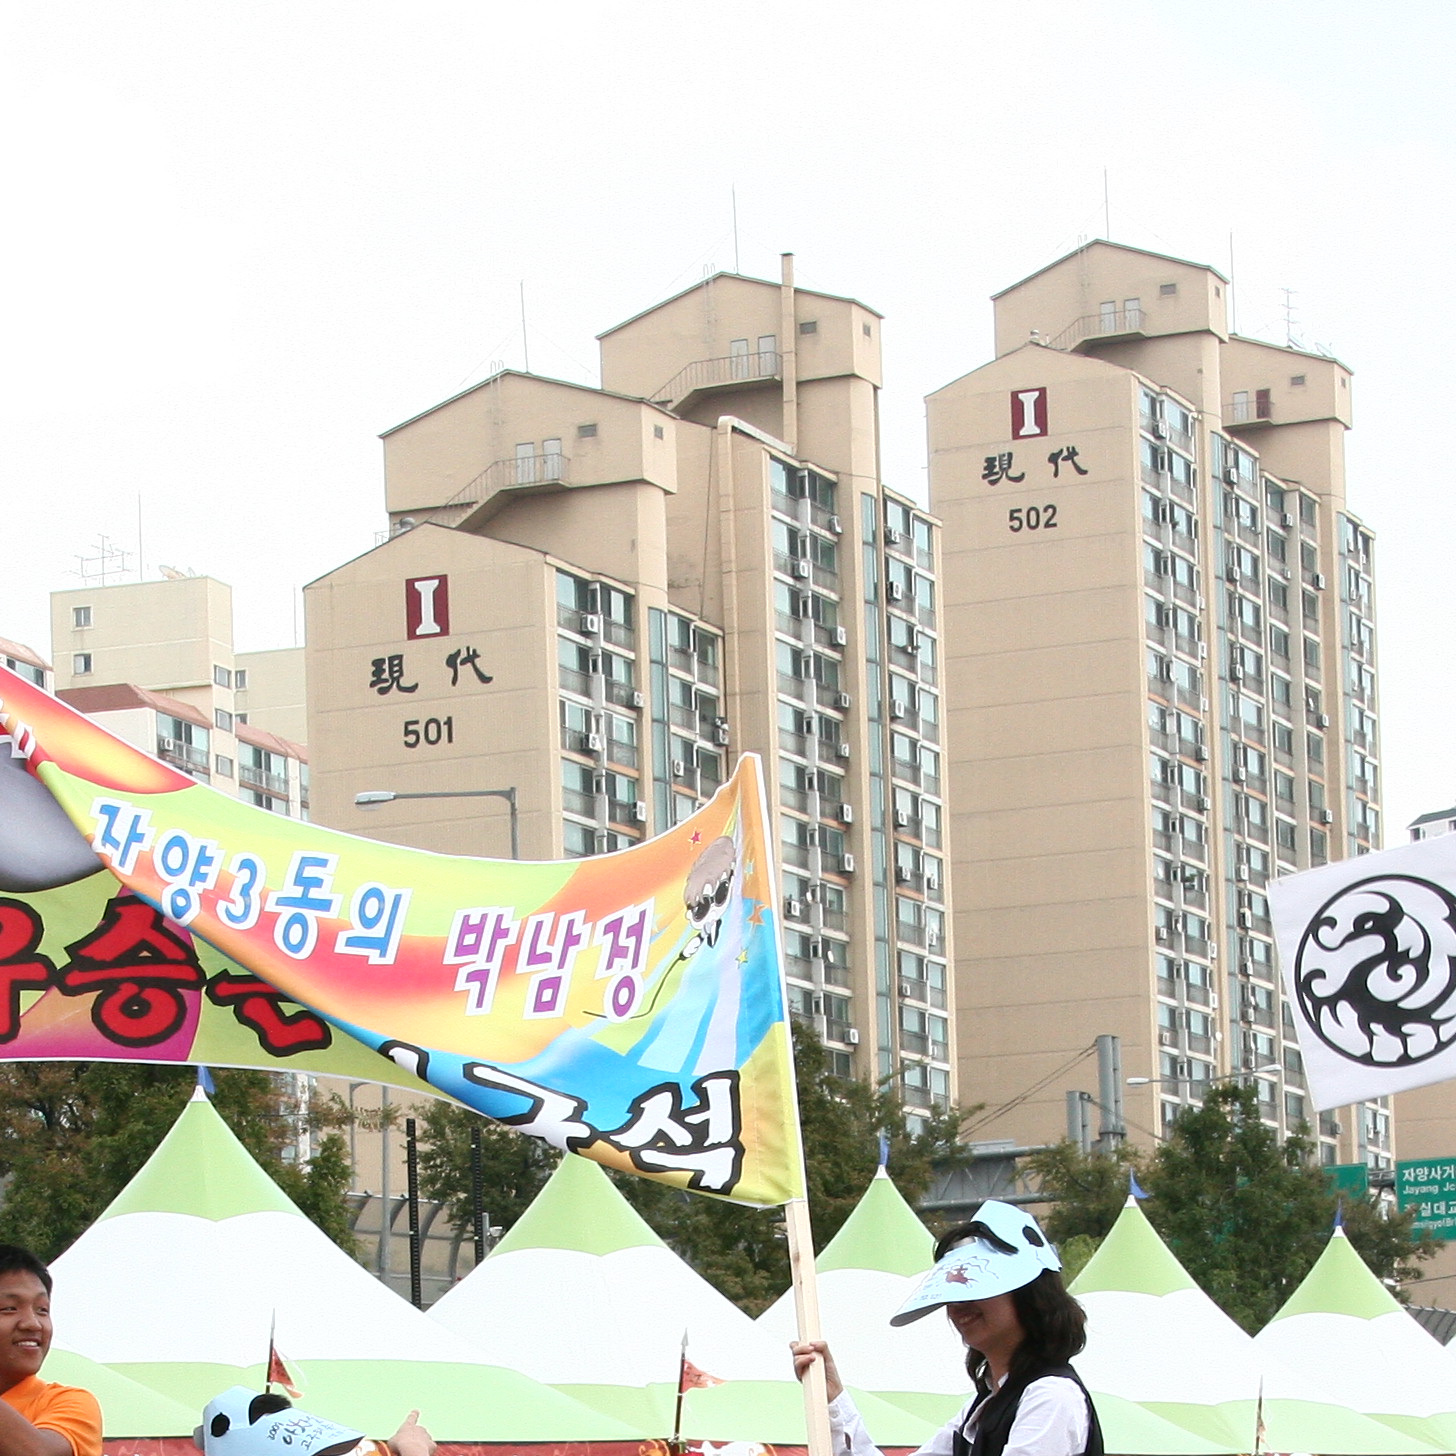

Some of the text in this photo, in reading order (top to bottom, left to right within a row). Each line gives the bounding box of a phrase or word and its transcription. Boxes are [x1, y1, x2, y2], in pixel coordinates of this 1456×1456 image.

[1009, 504, 1057, 532] 502
[404, 716, 453, 748] 501
[91, 797, 657, 1022] 자양3동의 박남정
[1402, 1184, 1439, 1195] Jayang
